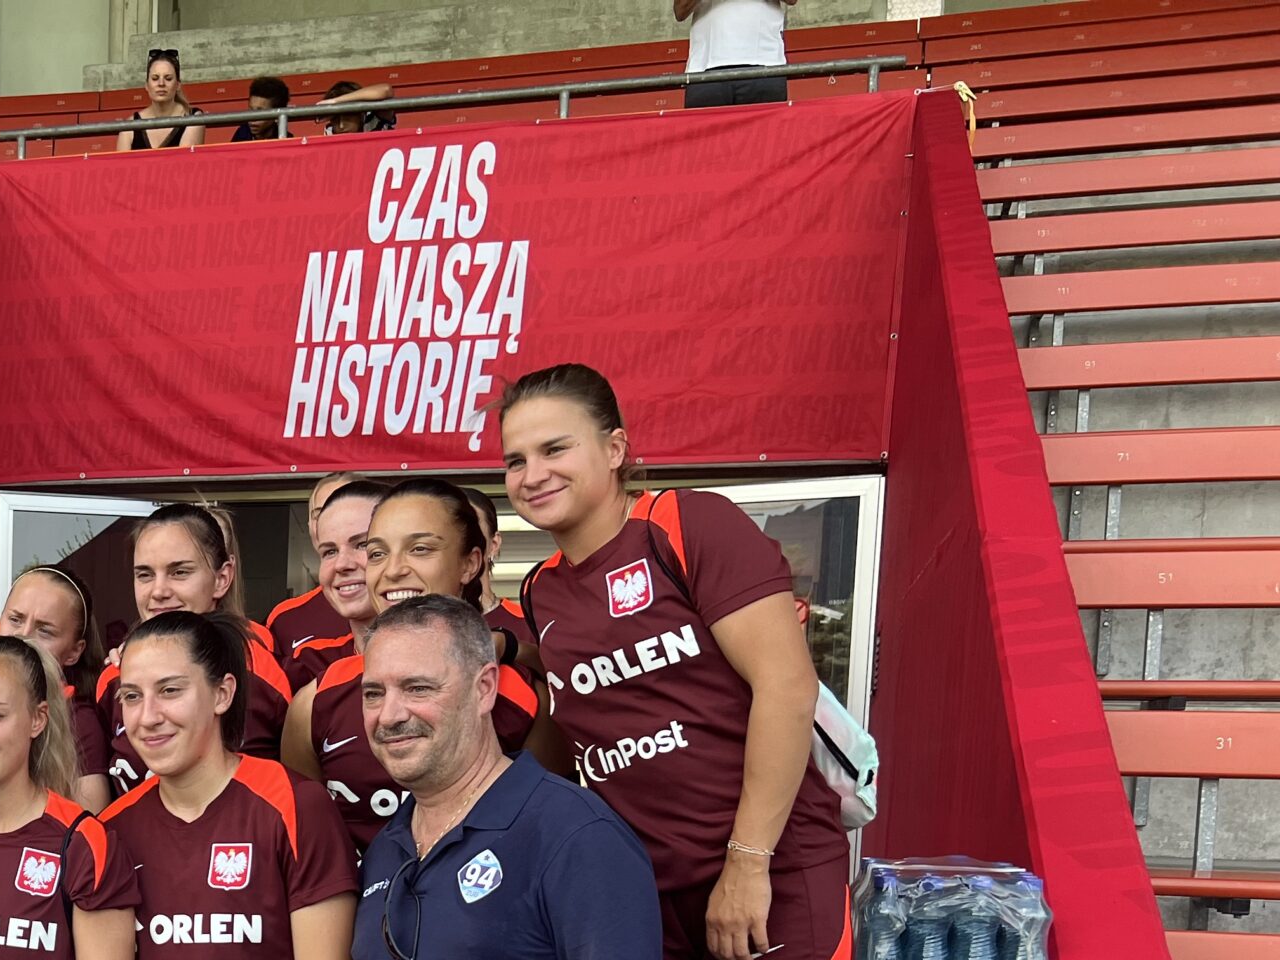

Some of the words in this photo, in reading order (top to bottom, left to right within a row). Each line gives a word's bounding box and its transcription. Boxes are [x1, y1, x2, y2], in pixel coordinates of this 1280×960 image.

[367, 141, 497, 244] CZAS
[294, 249, 364, 343] NA
[368, 240, 530, 354] NASZĄ
[283, 339, 500, 452] HISTORIĘ
[1117, 452, 1129, 463] 71
[1157, 572, 1173, 584] 51
[570, 624, 700, 696] ORLEN
[597, 720, 688, 775] InPost
[1216, 737, 1232, 750] 31
[463, 863, 499, 891] 94
[149, 913, 263, 945] ORLEN
